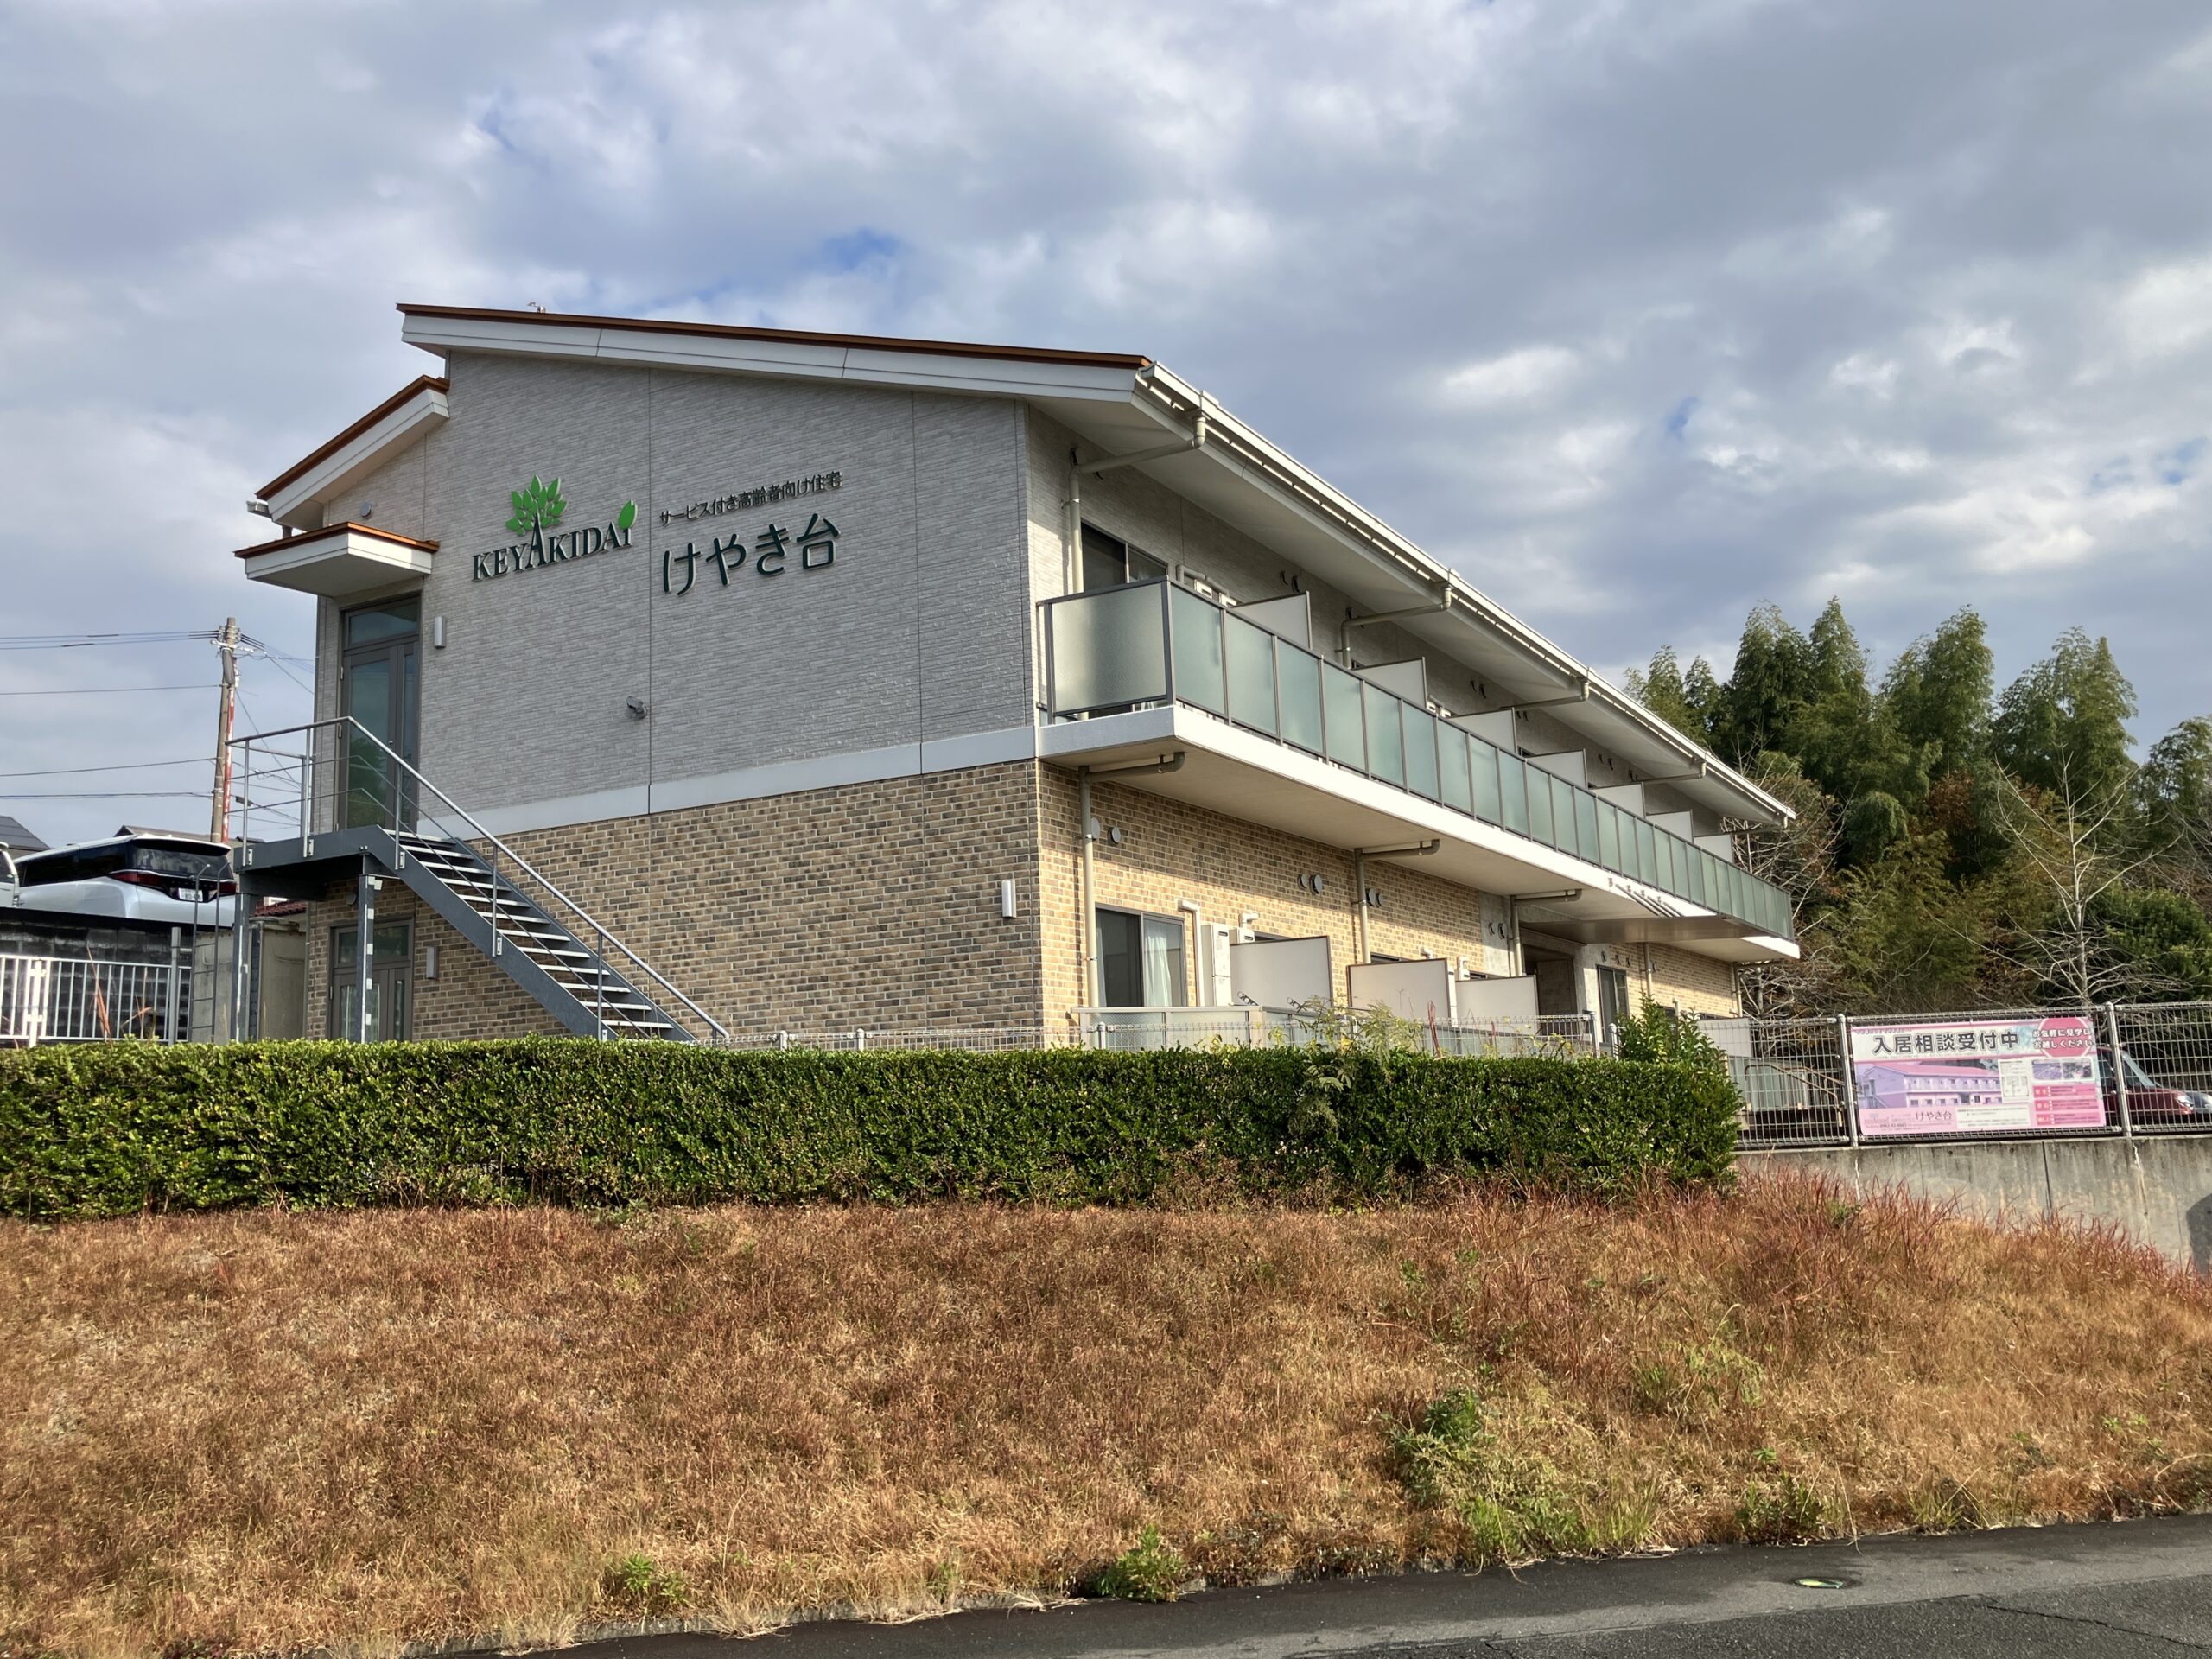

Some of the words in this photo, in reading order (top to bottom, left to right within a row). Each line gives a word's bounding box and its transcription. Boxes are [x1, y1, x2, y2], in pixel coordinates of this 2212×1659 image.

[660, 470, 842, 527] サービス付き高齢者向け住宅
[663, 512, 842, 596] けやき台
[1873, 1031, 2018, 1054] 入居相談受付中
